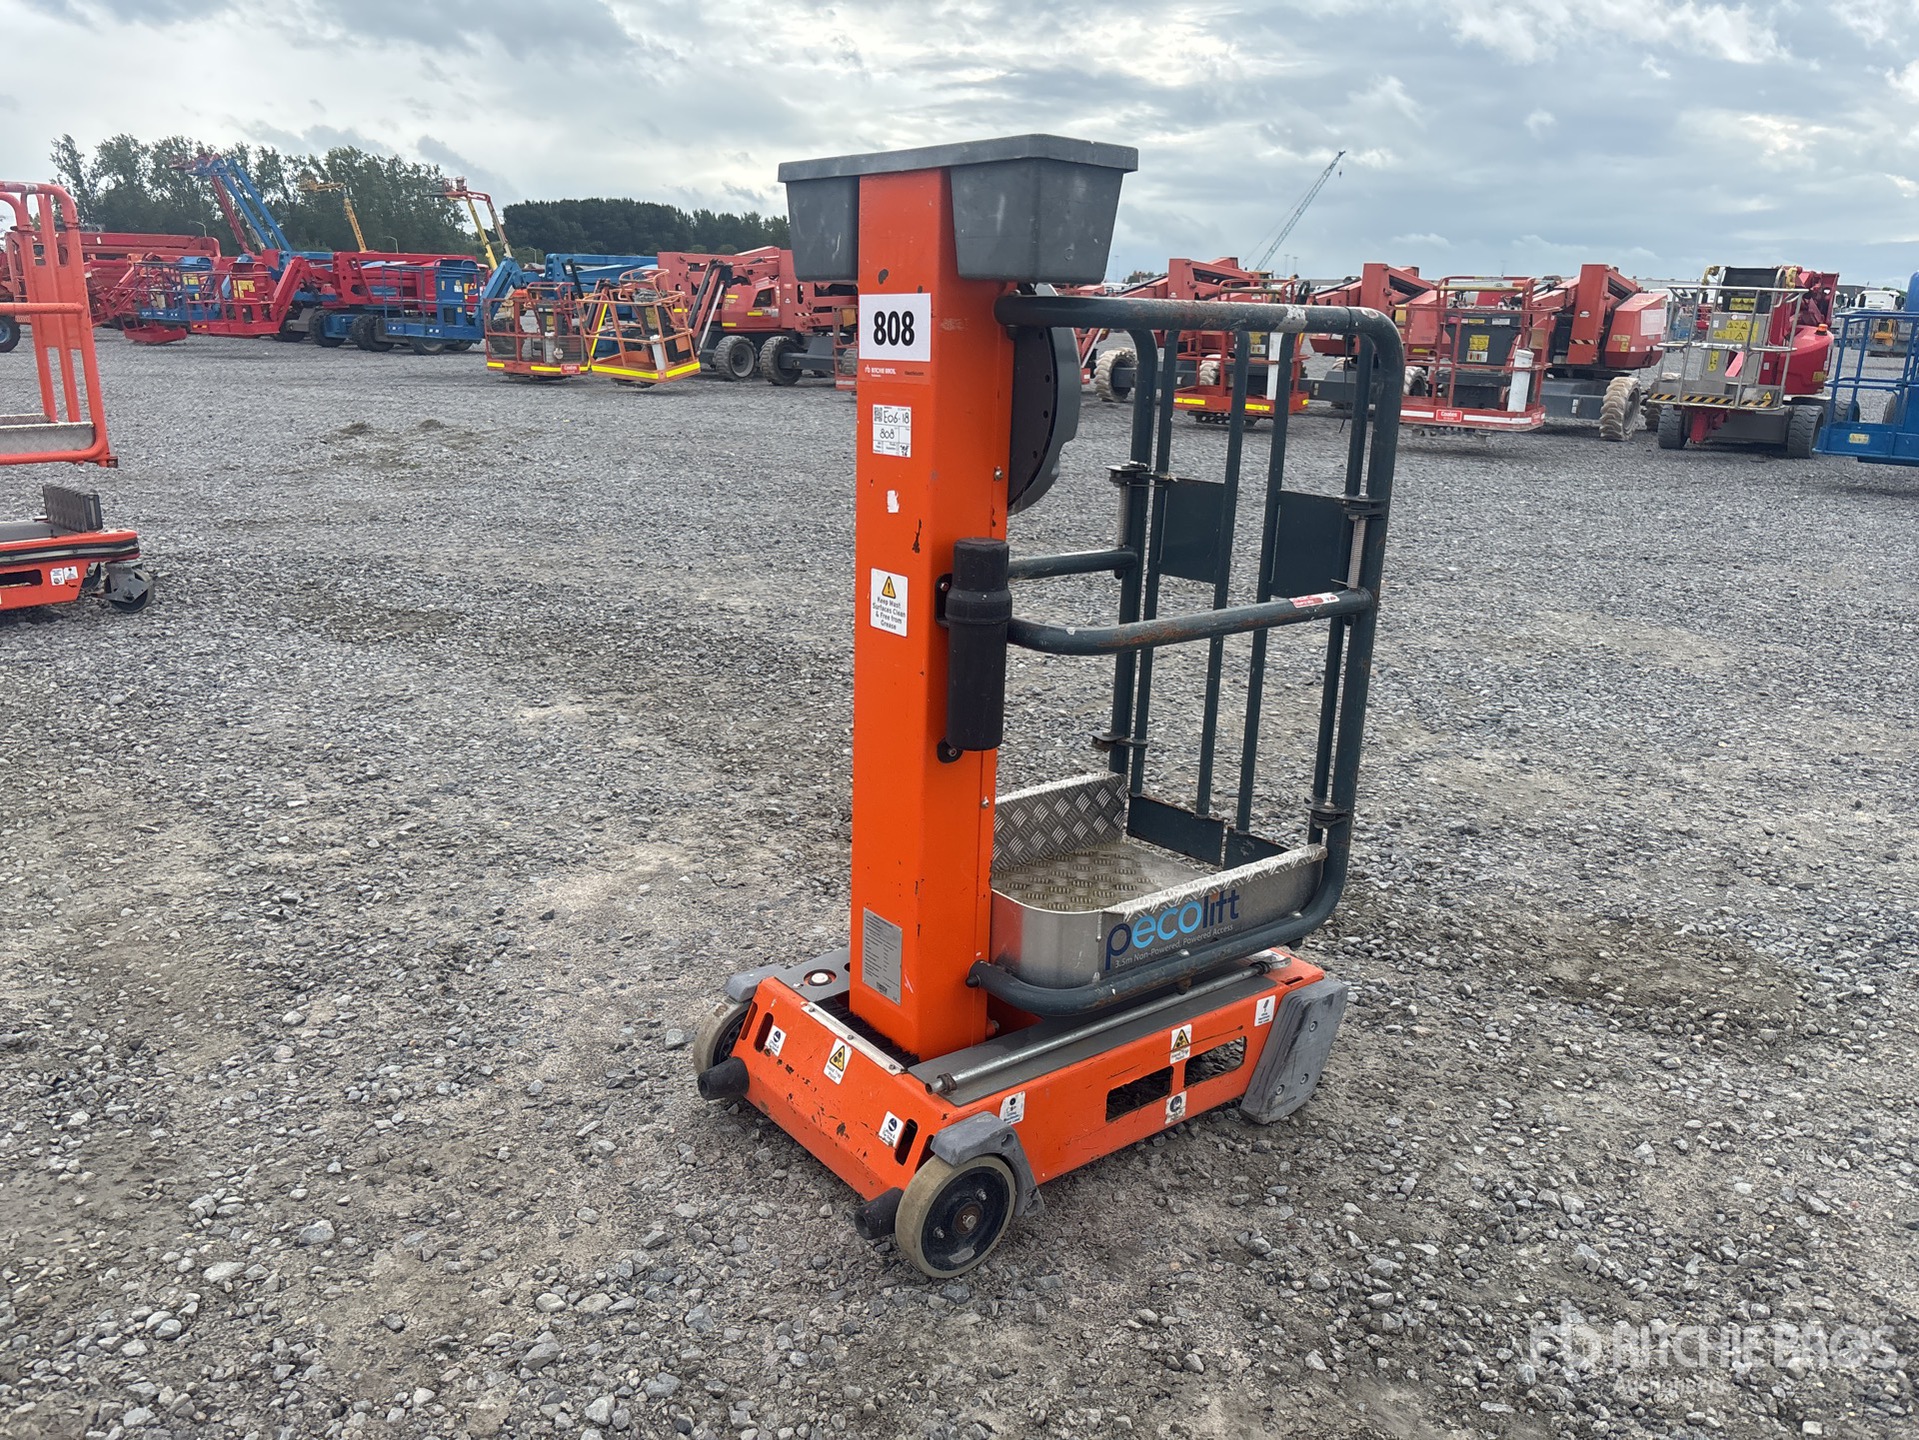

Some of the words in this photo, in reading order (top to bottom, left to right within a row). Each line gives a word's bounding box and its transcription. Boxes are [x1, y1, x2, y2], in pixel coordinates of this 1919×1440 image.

[873, 310, 915, 346] 808
[872, 602, 892, 614] Surfaces
[892, 608, 906, 618] Clean
[880, 612, 890, 620] Free
[891, 615, 903, 624] from
[880, 619, 897, 630] Grease
[1105, 889, 1240, 970] pecolift
[1115, 957, 1133, 968] 3.5m
[1182, 930, 1211, 946] Powered
[1212, 924, 1234, 937] Access
